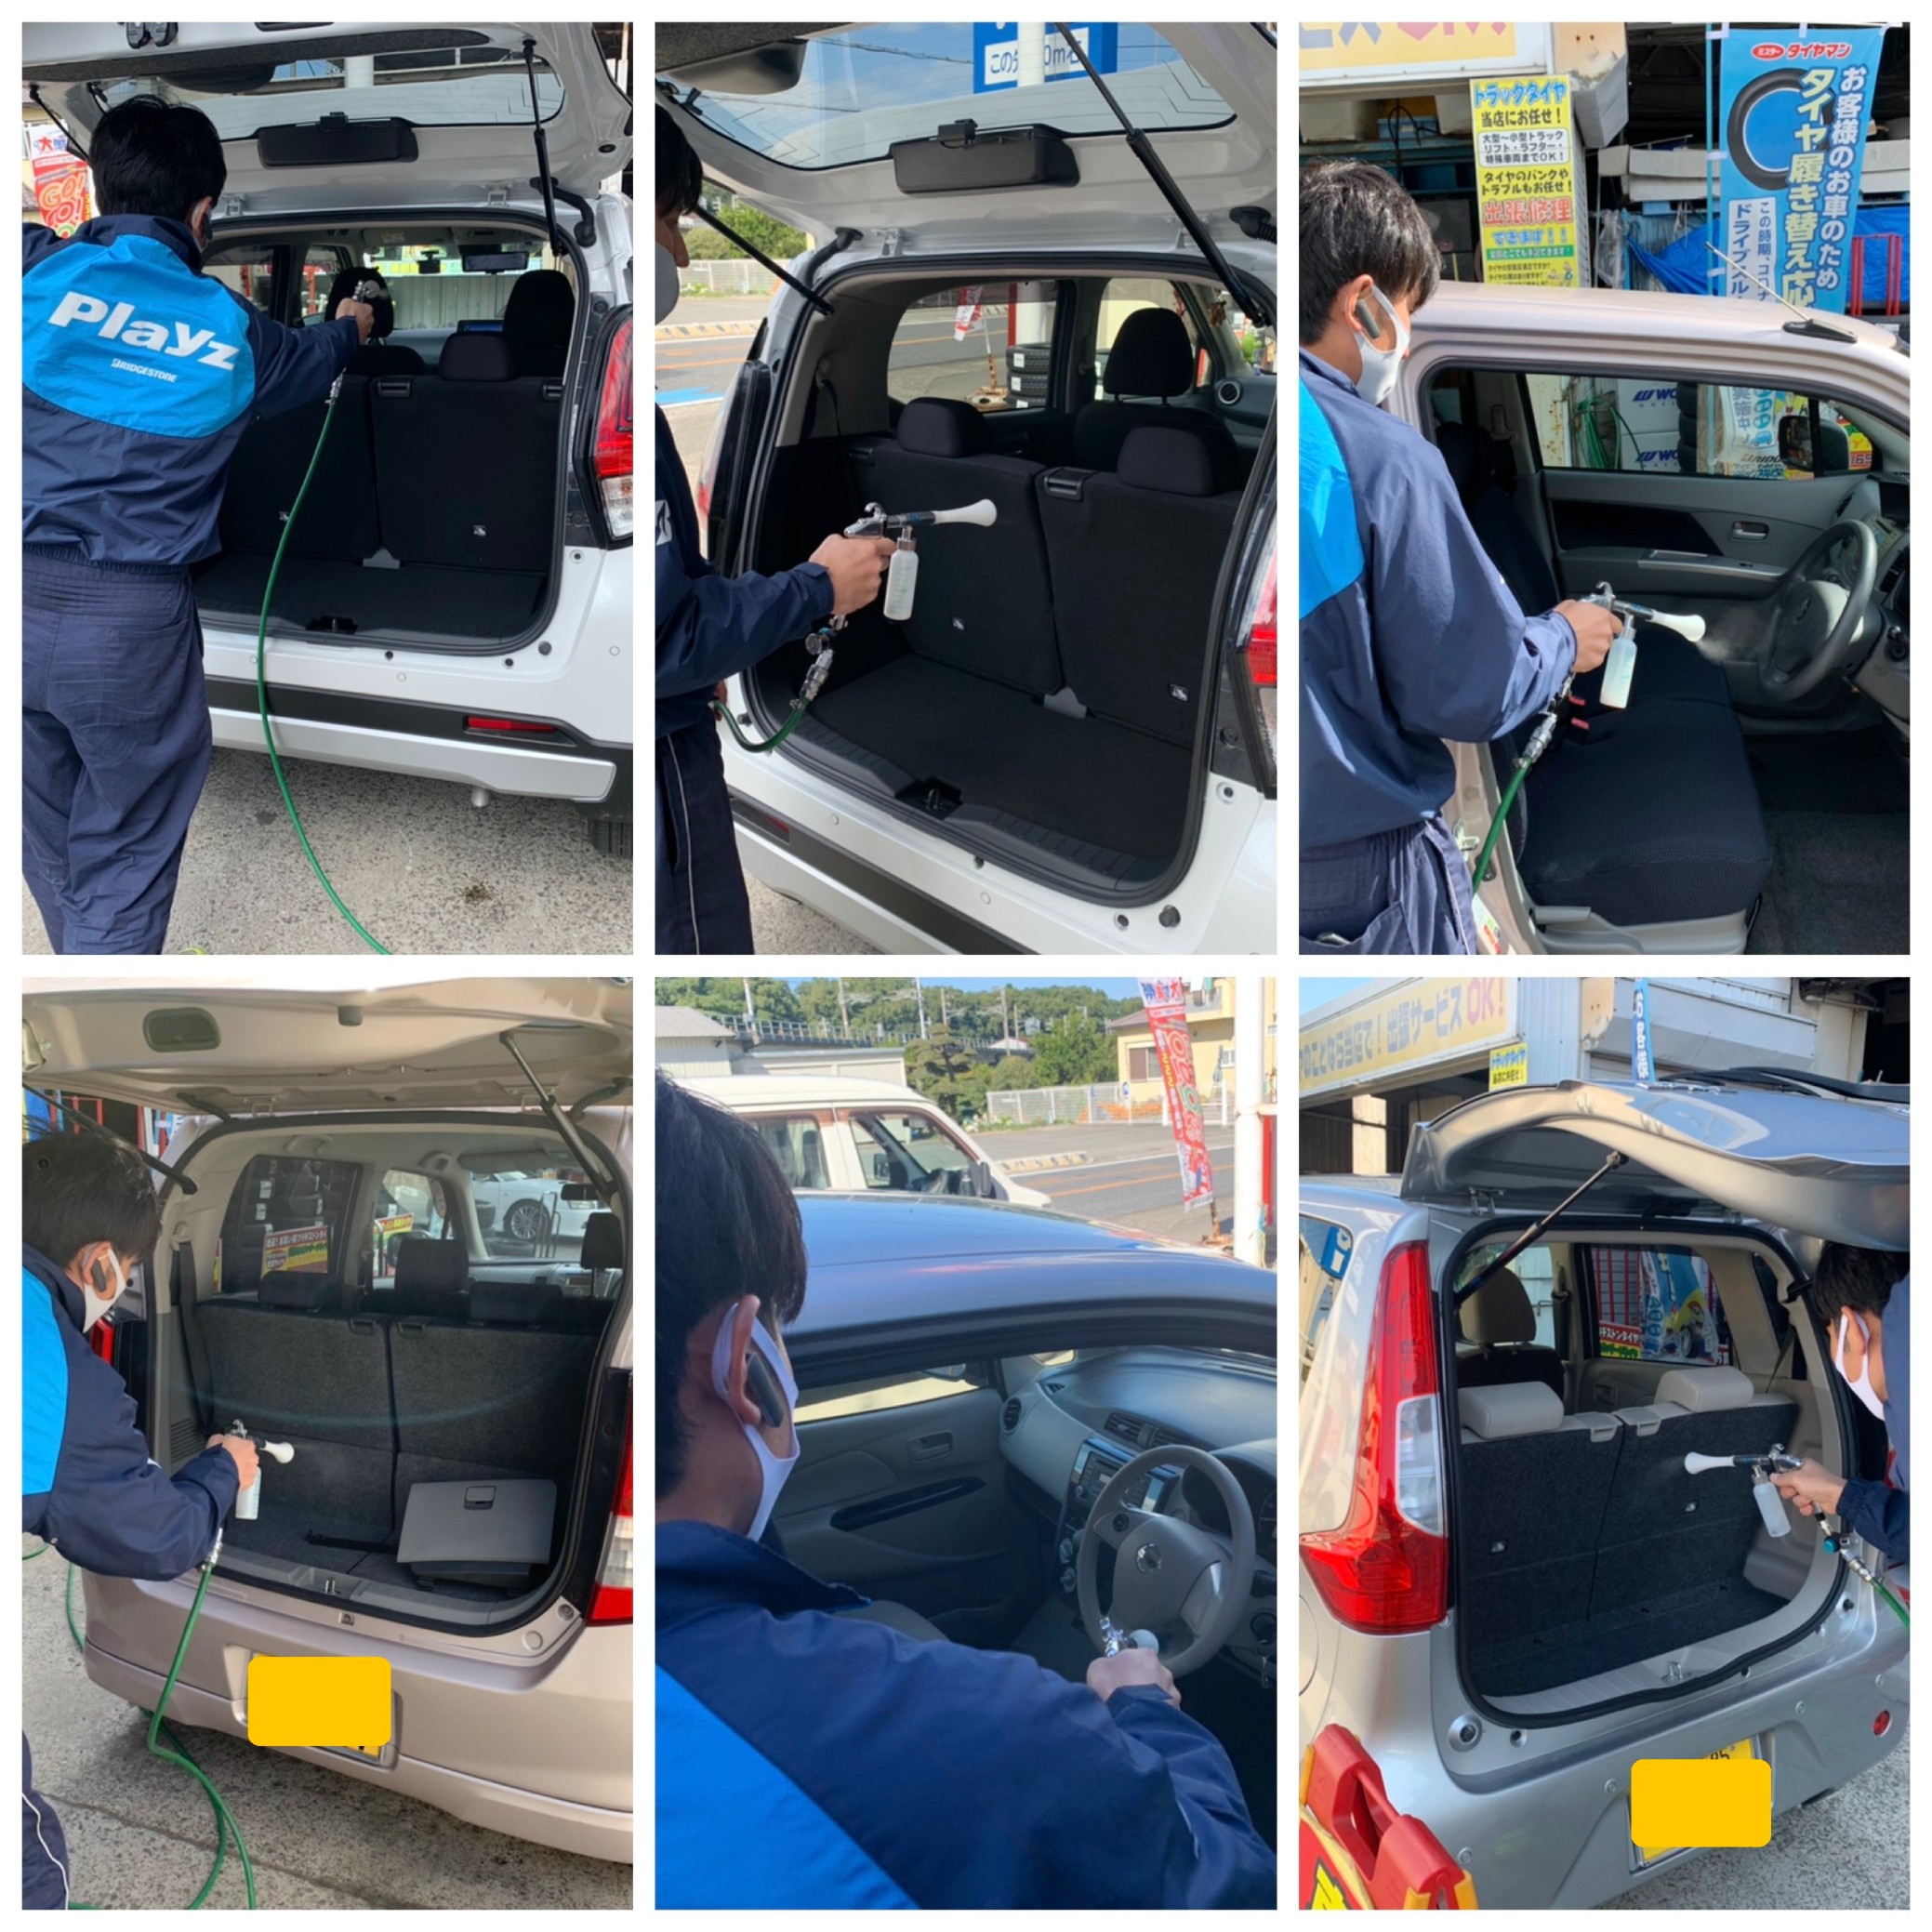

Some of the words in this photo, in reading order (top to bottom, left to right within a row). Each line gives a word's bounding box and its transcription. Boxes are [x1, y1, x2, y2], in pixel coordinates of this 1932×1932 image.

[1786, 43, 1853, 60] タイヤマン
[1474, 81, 1568, 109] トラックタイヤ
[1481, 107, 1562, 127] 当店にお任せ！
[1816, 64, 1868, 291] お客様のお車のため
[1482, 195, 1573, 227] 出張修理
[1731, 204, 1753, 299] ドライブスル
[48, 291, 239, 370] Playz
[111, 358, 178, 383] BRIDGESTONE
